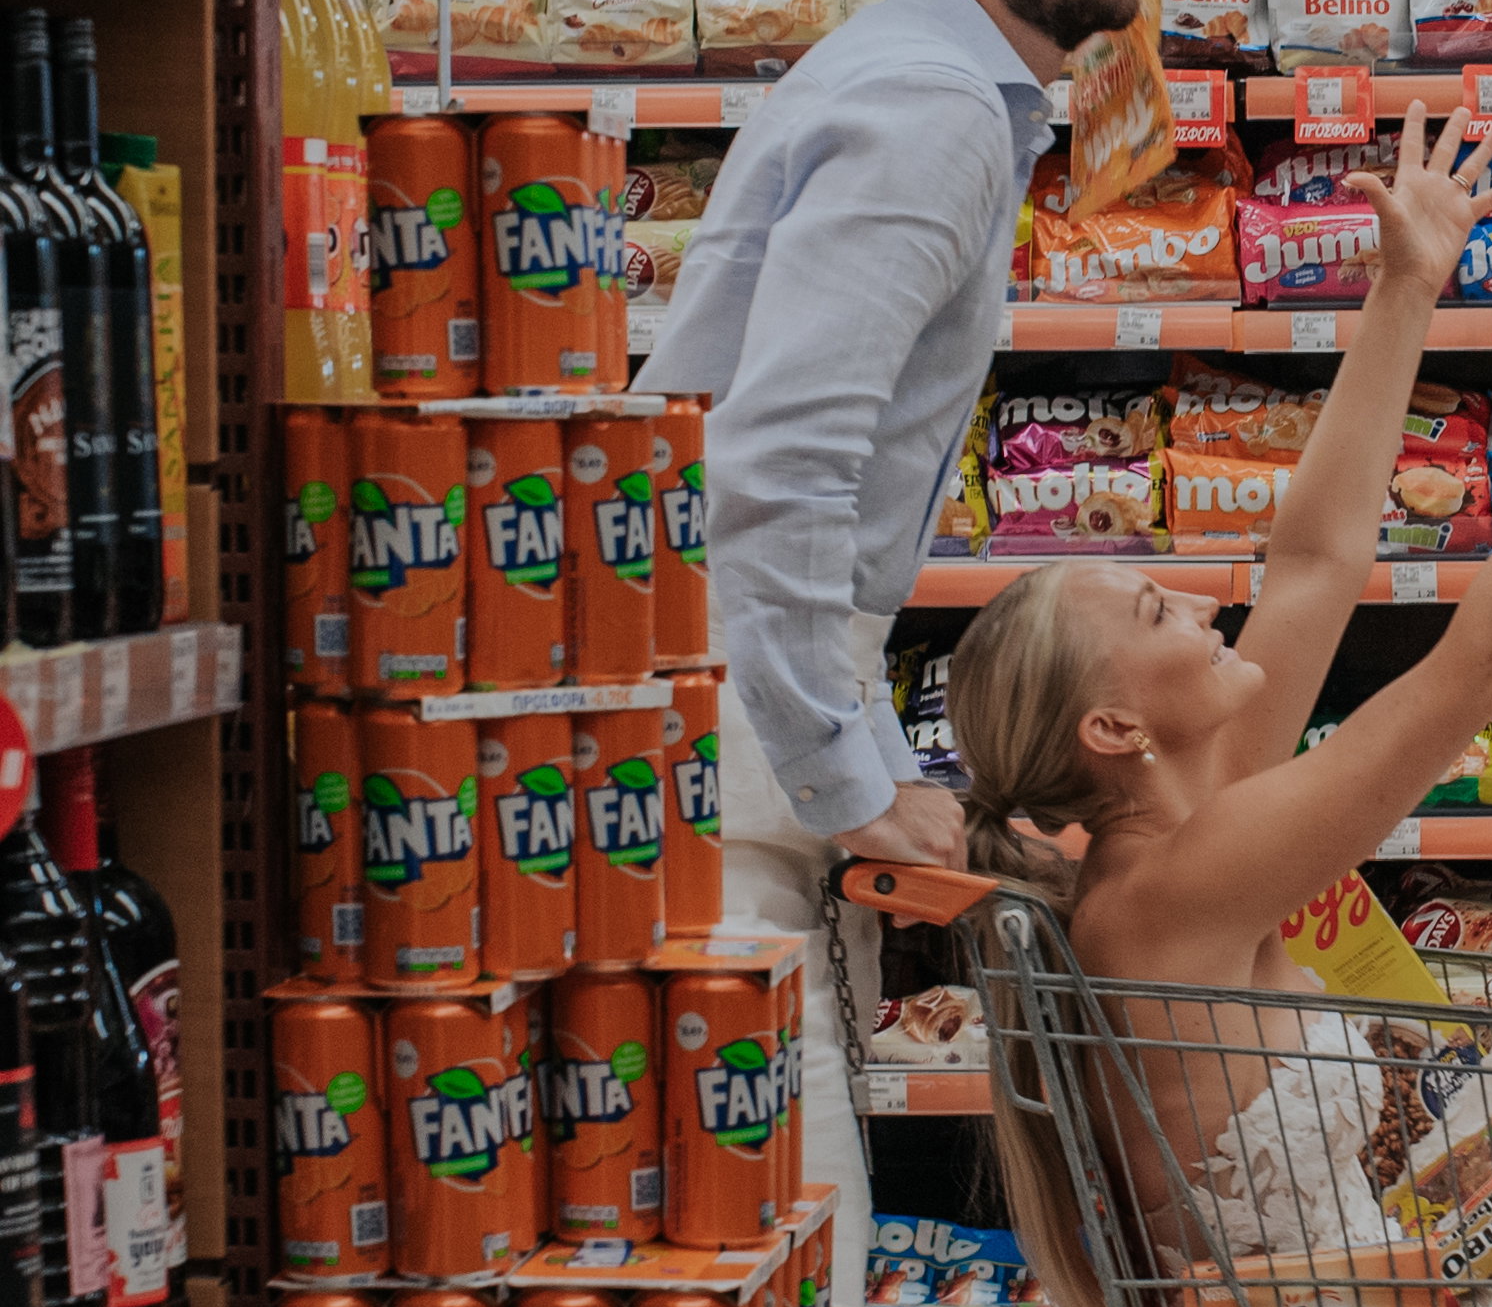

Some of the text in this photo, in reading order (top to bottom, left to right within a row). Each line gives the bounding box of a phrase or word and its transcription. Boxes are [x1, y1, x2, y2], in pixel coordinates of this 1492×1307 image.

[1173, 125, 1223, 143] ΟΣΦΟΡΑ
[1298, 121, 1367, 139] ΠΡΟΣΦΟΡΑ
[371, 207, 448, 268] NTA
[493, 209, 596, 278] FANT
[1047, 225, 1221, 292] Jumbo
[1246, 225, 1381, 284] Jum
[987, 462, 1151, 514] molto
[1173, 468, 1291, 514] mol
[351, 504, 459, 568] ANTA
[484, 503, 564, 568] FAN
[511, 691, 588, 711] ΠΡΟΣΦΟΡΑ
[364, 798, 473, 862] ANTA
[499, 790, 575, 858] FAN
[586, 787, 664, 849] FAN
[274, 1095, 349, 1154] NTA
[695, 1066, 774, 1133] FAN
